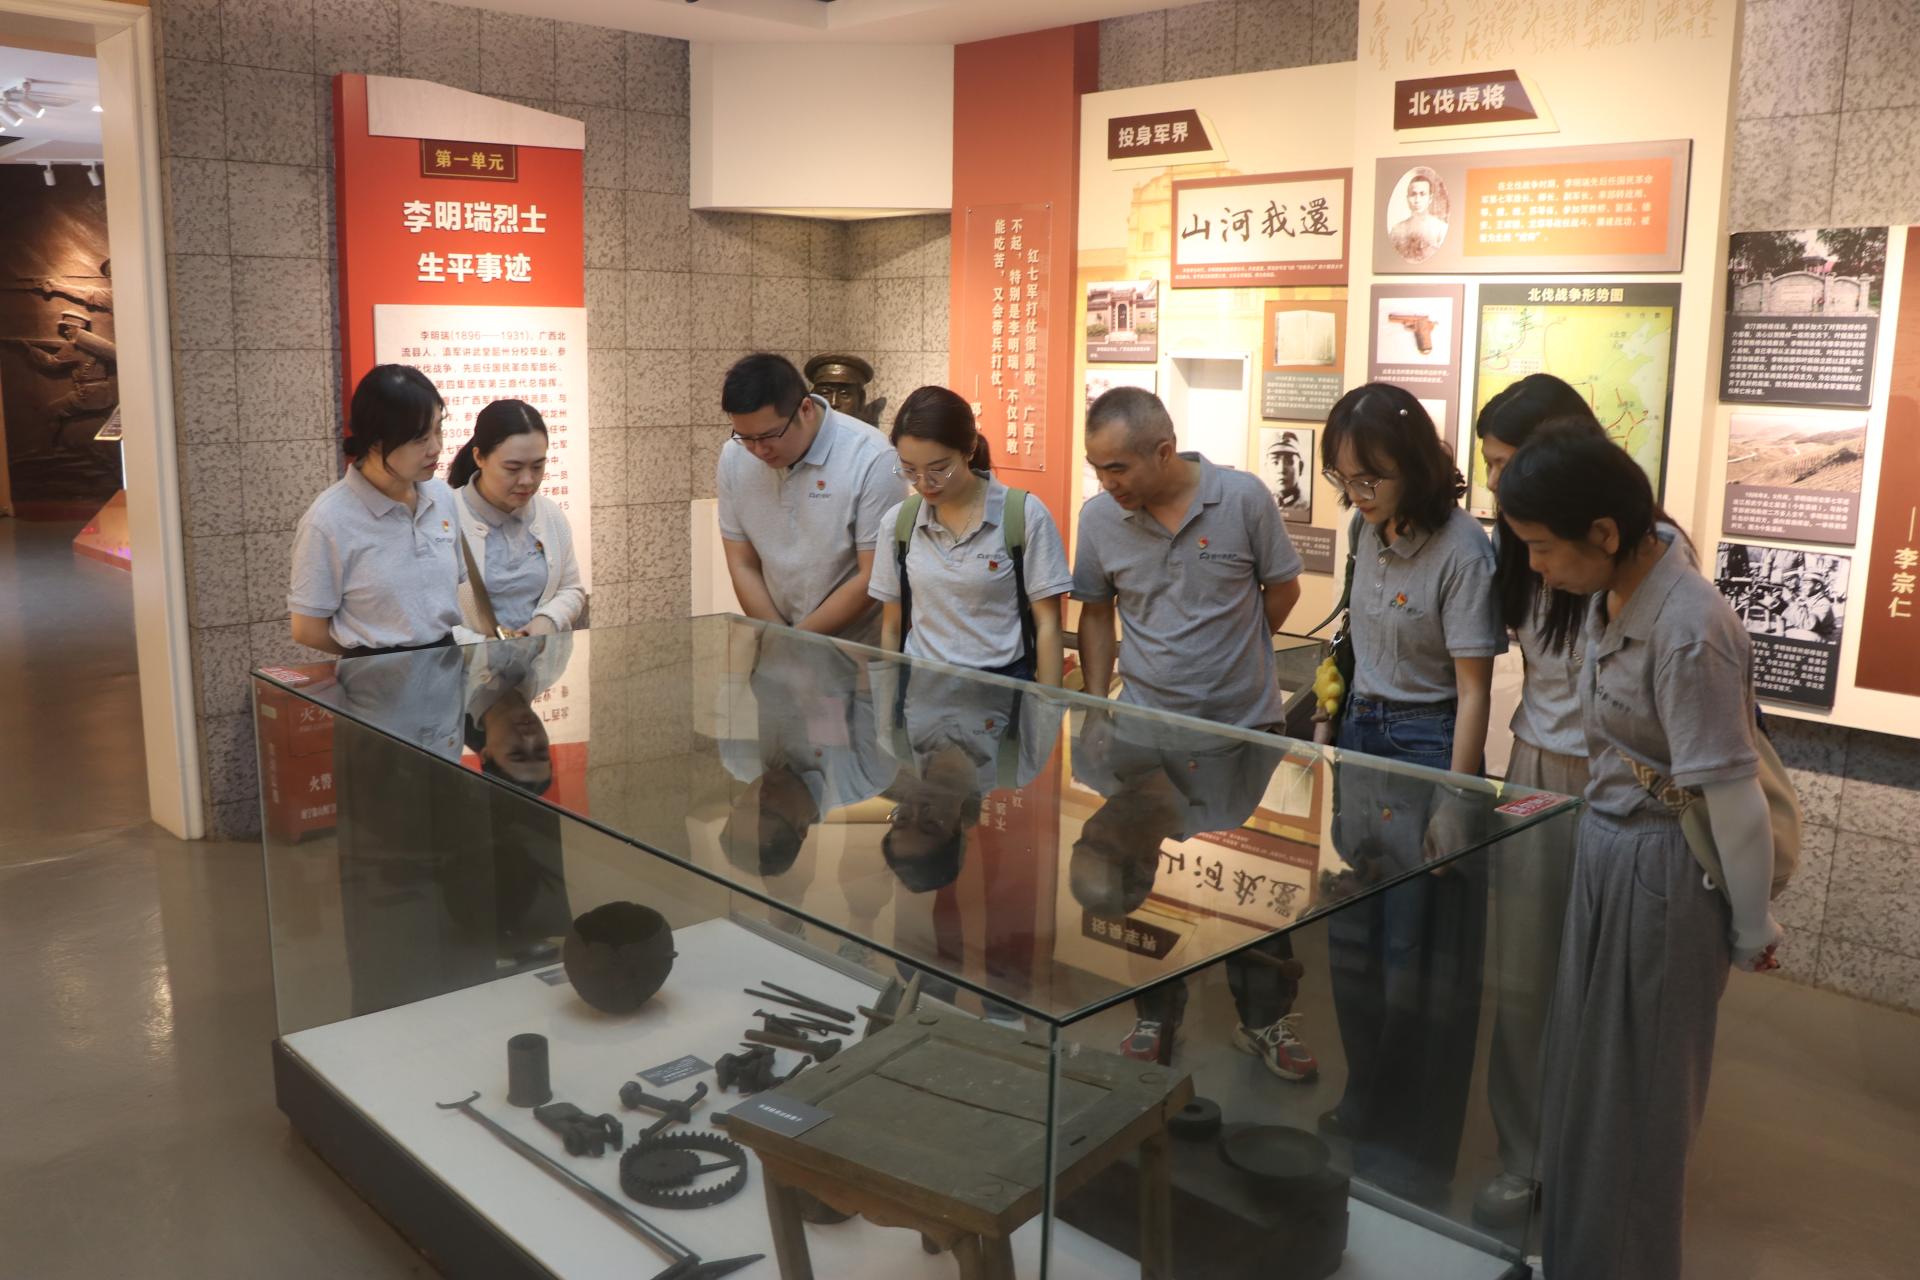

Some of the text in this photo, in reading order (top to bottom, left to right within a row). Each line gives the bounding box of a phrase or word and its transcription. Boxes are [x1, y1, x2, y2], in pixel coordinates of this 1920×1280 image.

[1407, 84, 1506, 116] 北伐虎将
[1118, 121, 1189, 149] 投身军界
[435, 149, 505, 171] 第一单元
[403, 200, 547, 233] 李明瑞烈士
[417, 251, 532, 283] 生平事迹
[1528, 287, 1625, 302] 北伐战争形势图
